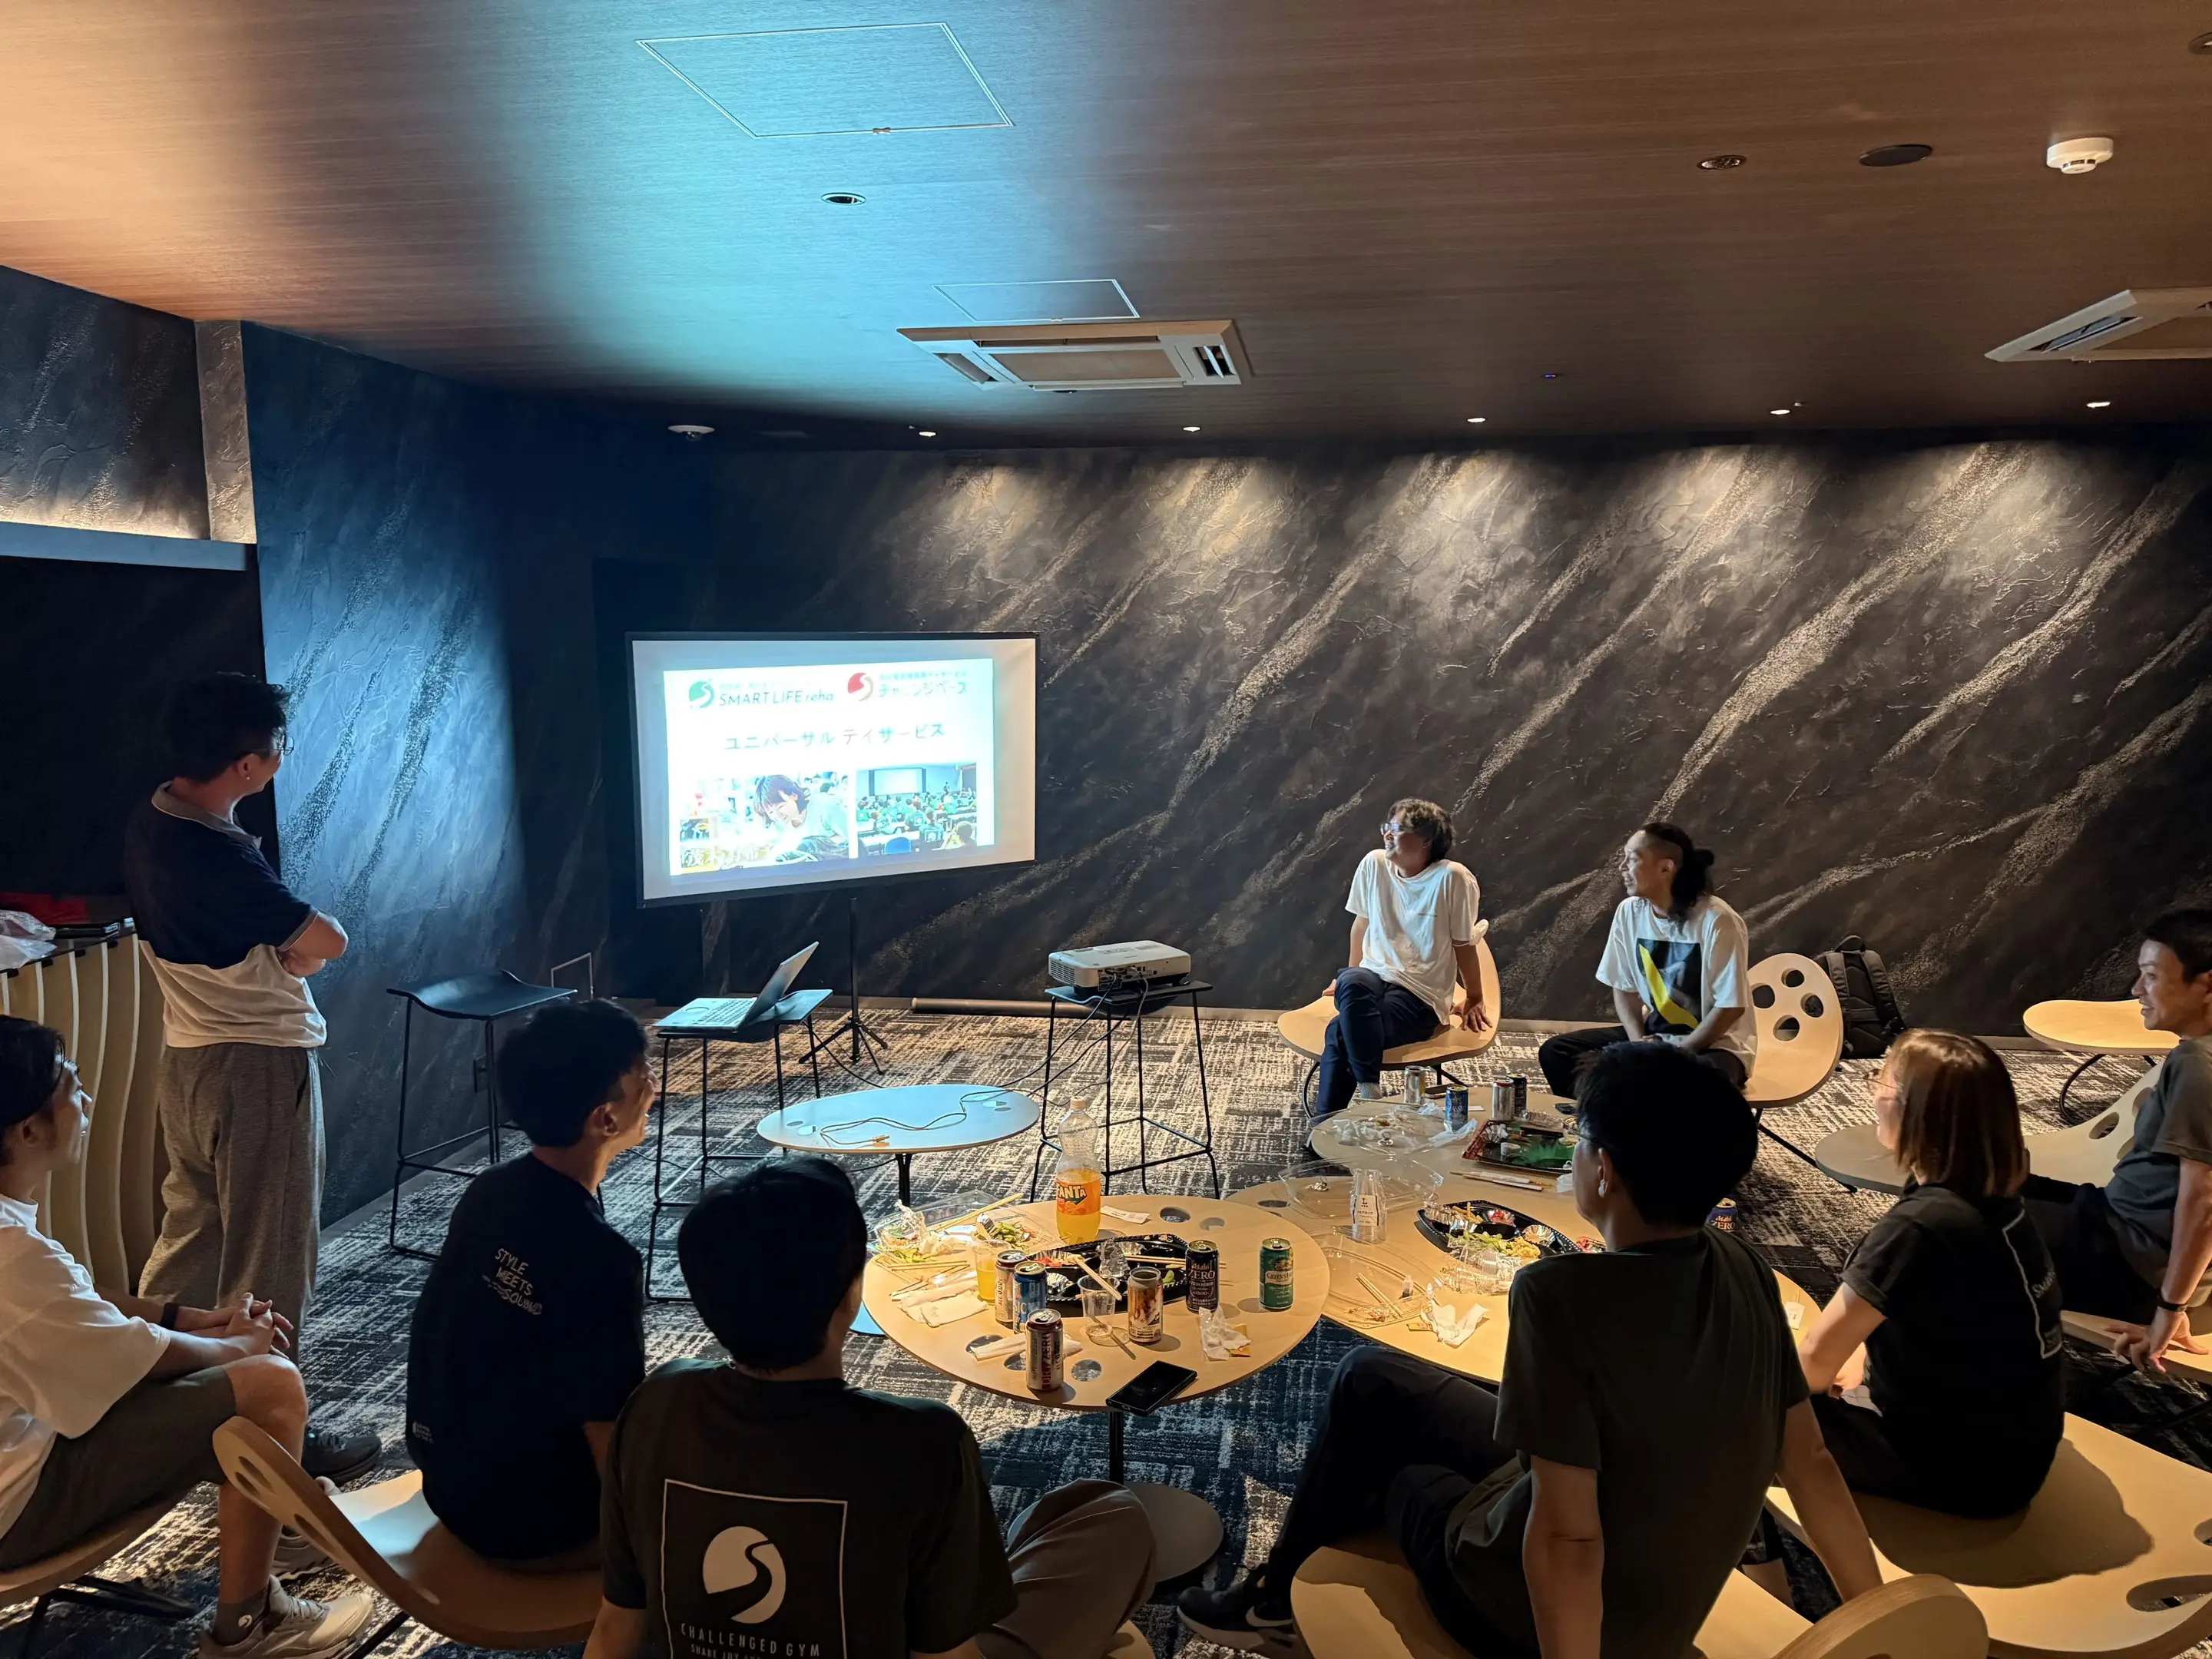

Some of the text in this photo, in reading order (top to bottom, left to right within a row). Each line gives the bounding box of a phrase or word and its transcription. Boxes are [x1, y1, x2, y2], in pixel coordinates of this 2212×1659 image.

[718, 690, 770, 707] SMART
[772, 690, 803, 704] LIFE
[495, 1248, 529, 1275] STYLE
[680, 1622, 820, 1657] CHALLENGED GYM
